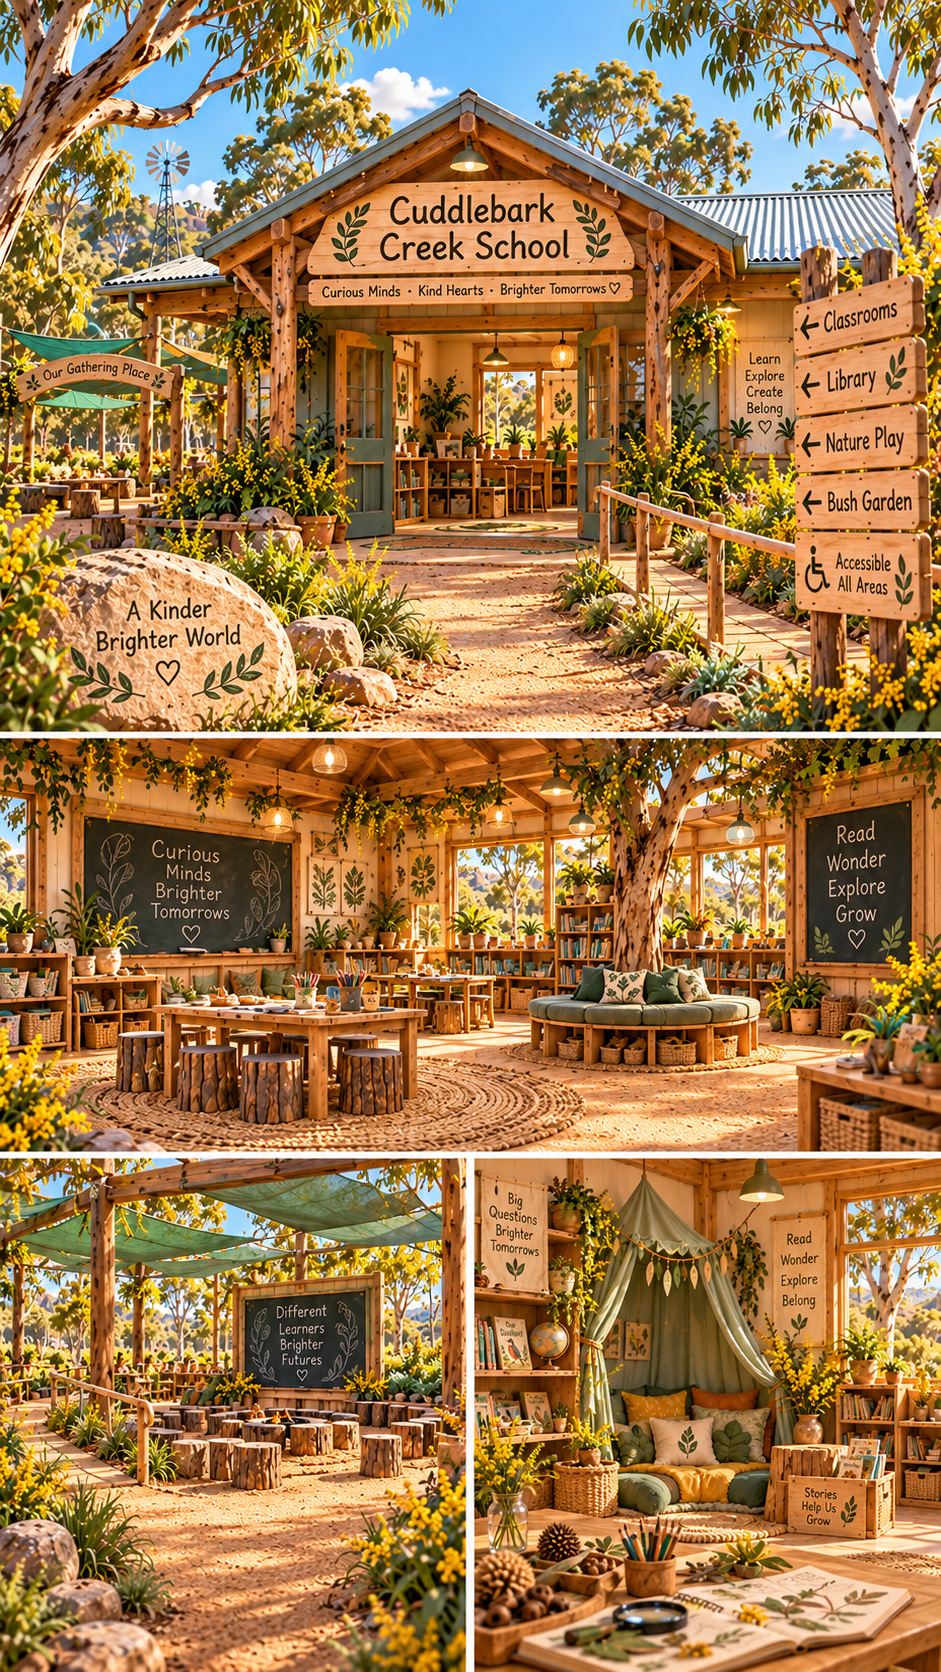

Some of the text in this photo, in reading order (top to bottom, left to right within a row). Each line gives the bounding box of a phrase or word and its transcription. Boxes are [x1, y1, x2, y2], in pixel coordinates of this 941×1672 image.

[390, 193, 555, 225] Cuddlebark
[380, 229, 569, 261] Creek School
[322, 283, 606, 298] Curious Minds Kind Hearts Brighter Tomorrows
[824, 303, 897, 332] Classrooms
[749, 352, 781, 365] Learn
[43, 361, 150, 381] Our Gathering Place
[746, 369, 784, 384] Explore
[828, 369, 876, 393] Library
[747, 386, 783, 397] Create
[747, 402, 782, 417] Belong
[827, 426, 904, 455] Nature Play
[828, 489, 912, 512] Bush Garden
[836, 553, 891, 571] Accessible
[837, 575, 887, 595] All Areas
[126, 597, 212, 621] A Kinder
[96, 624, 241, 657] Brighter World
[836, 820, 876, 844] Read
[152, 839, 220, 863] Curious
[826, 848, 886, 872] Wonder
[166, 863, 211, 882] Minds
[156, 882, 222, 904] Brighter
[828, 877, 886, 902] Explore
[151, 903, 229, 920] Tomorrows
[836, 904, 876, 923] Grow
[508, 1192, 522, 1210] Big
[489, 1205, 538, 1226] Questions
[496, 1223, 533, 1242] Brighter
[786, 1231, 812, 1246] Read
[490, 1239, 540, 1257] Tomorrows
[780, 1252, 819, 1266] Wonder
[781, 1273, 817, 1289] Explore
[783, 1294, 815, 1309] Belong
[276, 1304, 327, 1319] Different
[279, 1323, 325, 1336] Learners
[281, 1338, 323, 1353] Brighter
[281, 1353, 323, 1365] Futures
[805, 1487, 837, 1499] Stories
[801, 1501, 836, 1514] Help Us
[807, 1514, 831, 1526] Grow
